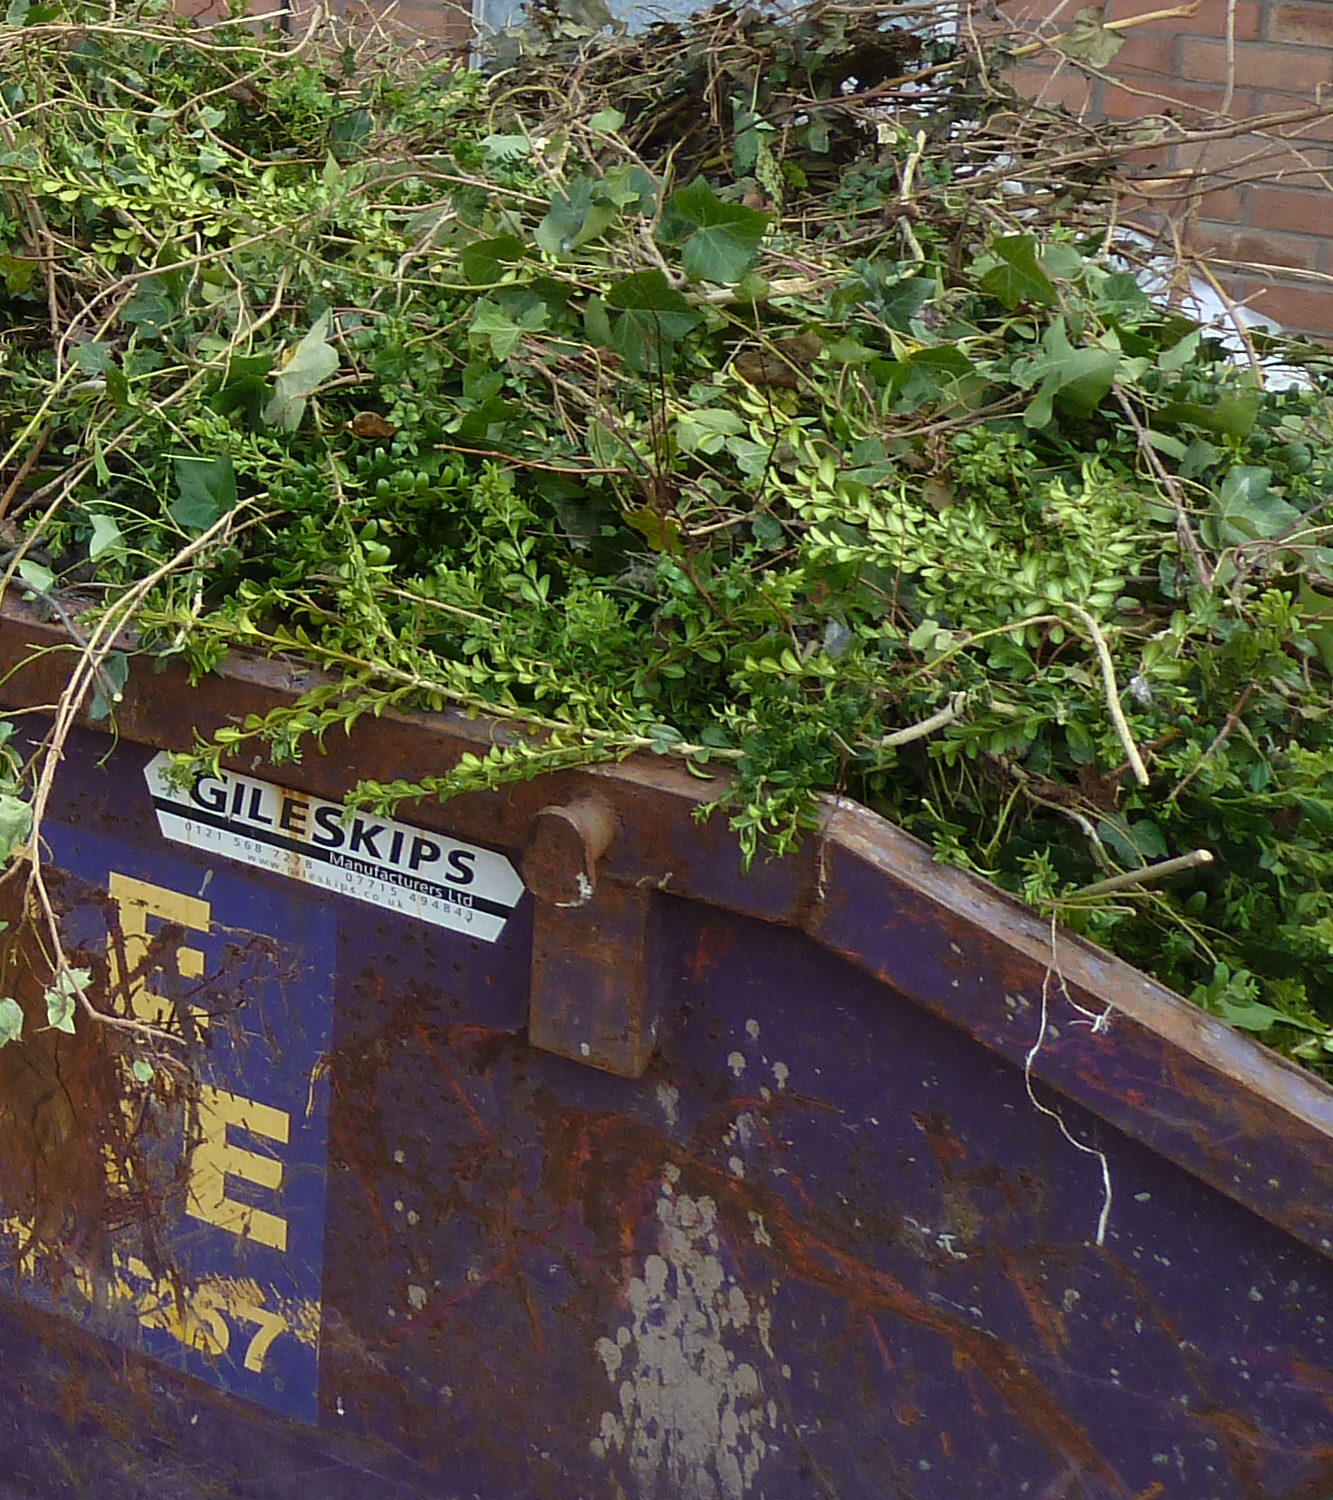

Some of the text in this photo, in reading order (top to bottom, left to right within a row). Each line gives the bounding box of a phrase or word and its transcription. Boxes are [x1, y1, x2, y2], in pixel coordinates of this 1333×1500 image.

[185, 821, 222, 840] 0121
[234, 838, 262, 853] 568
[190, 770, 476, 885] GILESKIPS
[247, 854, 404, 910] www.gileskips.couk
[330, 851, 474, 907] Manufacturers Ltd
[346, 872, 397, 896] 07715
